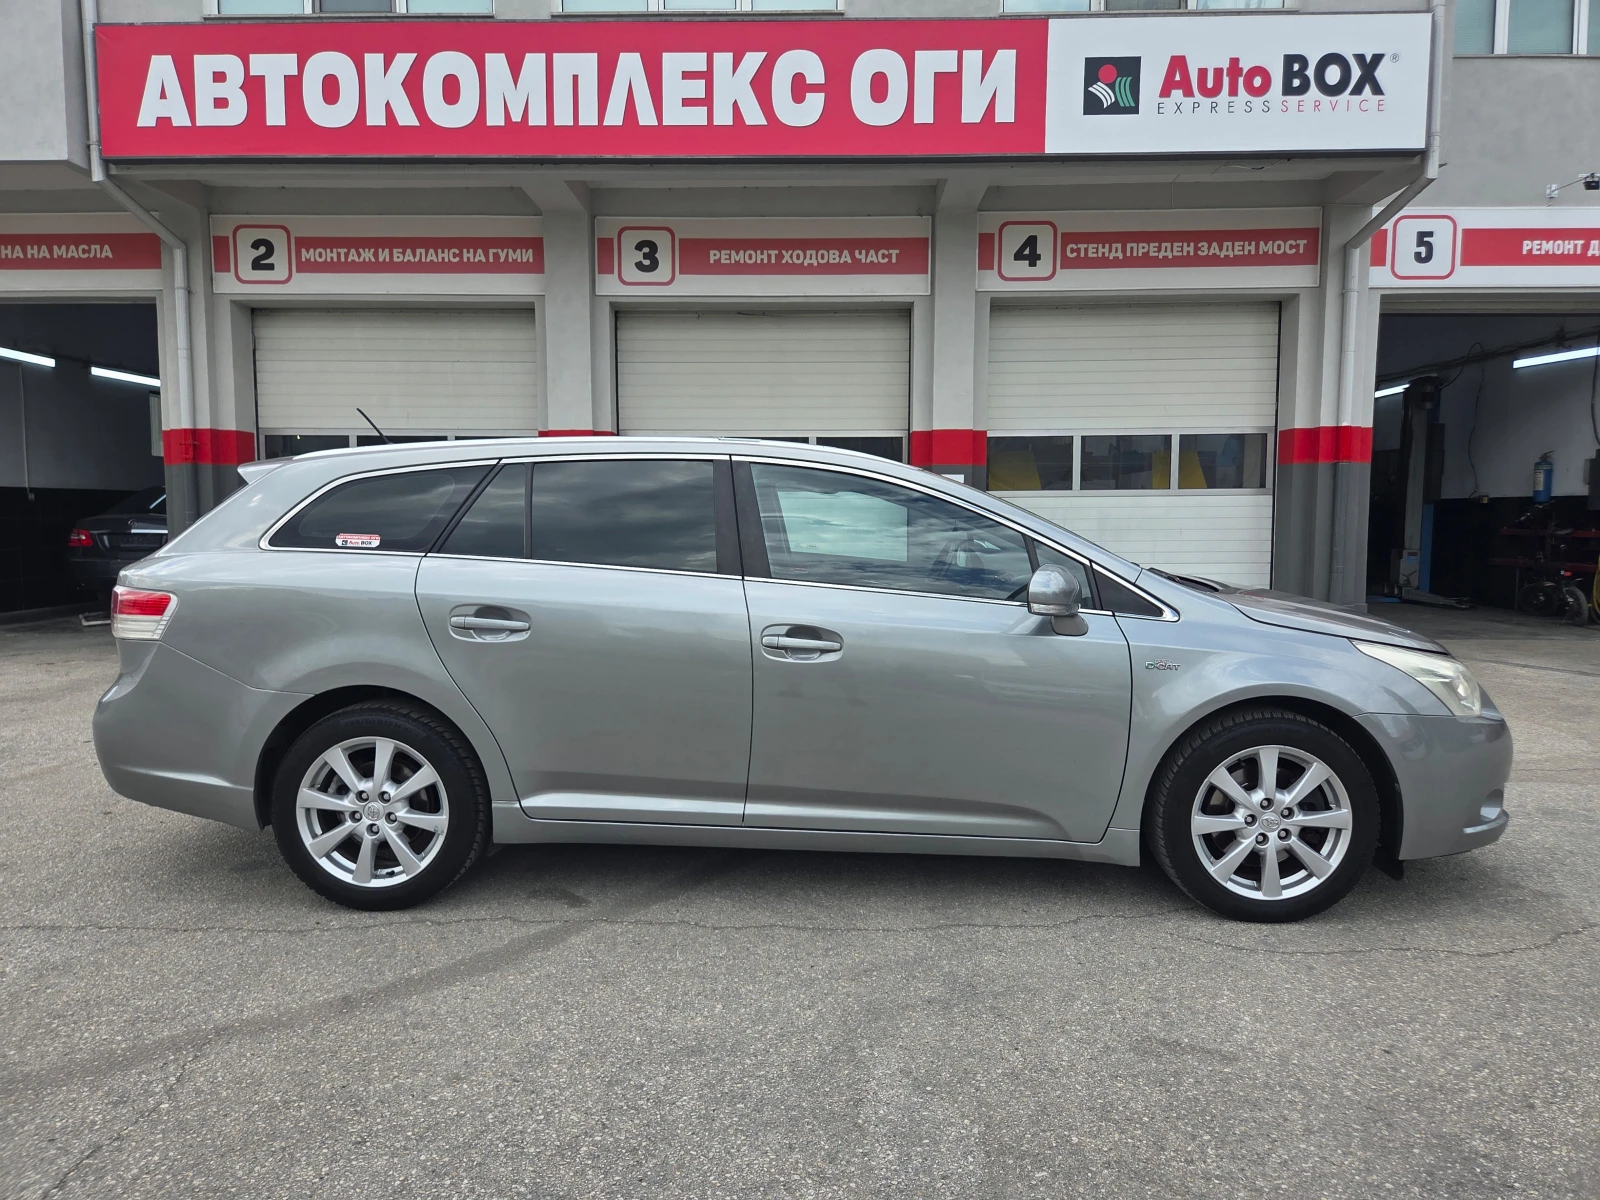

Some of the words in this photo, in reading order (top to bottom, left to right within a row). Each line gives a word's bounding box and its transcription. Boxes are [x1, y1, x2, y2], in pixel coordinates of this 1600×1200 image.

[136, 50, 826, 129] АВТОКОМПЛЕКС
[850, 48, 1017, 127] ОГИ
[1158, 54, 1273, 99] Auto
[1281, 52, 1386, 98] BOX
[1157, 100, 1271, 115] EXPRESS
[1280, 98, 1385, 113] SERVICE
[26, 244, 51, 259] НА
[53, 244, 113, 259] МАСЛА
[250, 238, 275, 271] 2
[301, 247, 376, 263] МОНТАЖ
[378, 248, 390, 263] И
[393, 248, 461, 263] БАЛАНС
[463, 248, 487, 263] НА
[489, 248, 534, 263] ГУМИ
[634, 239, 660, 273] 3
[709, 249, 779, 265] РЕМОНТ
[781, 249, 852, 267] ХОДОВА
[854, 249, 900, 264] ЧАСТ
[1013, 234, 1042, 268] 4
[1065, 243, 1124, 260] СТЕНД
[1126, 242, 1195, 259] ПРЕДЕН
[1197, 241, 1256, 259] ЗАДЕН
[1258, 239, 1308, 256] МОСТ
[1413, 230, 1434, 264] 5
[1522, 240, 1585, 255] РЕМОНТ
